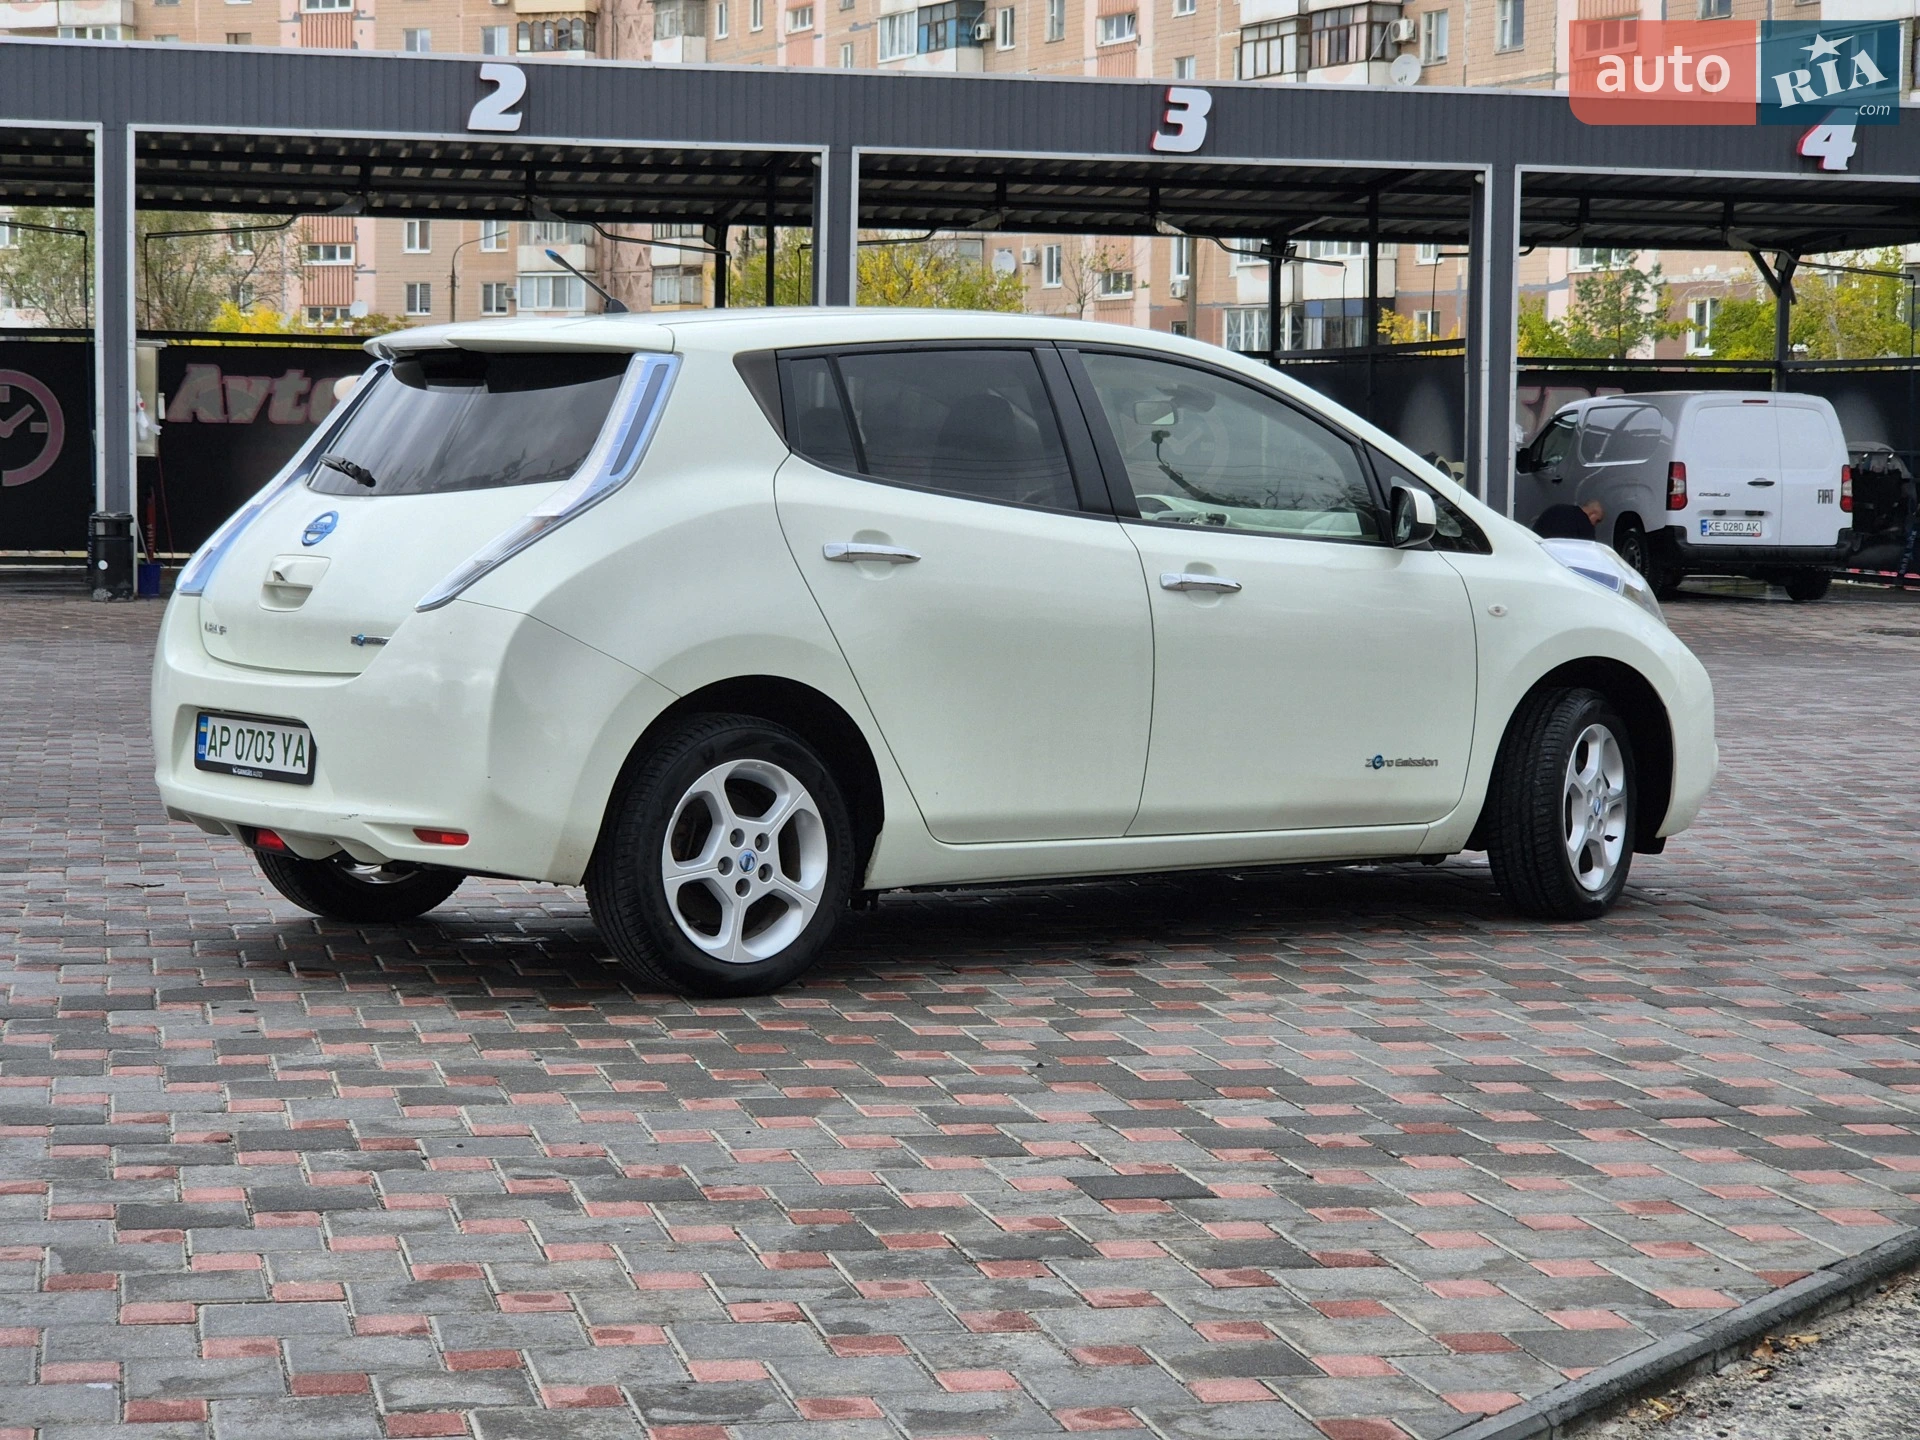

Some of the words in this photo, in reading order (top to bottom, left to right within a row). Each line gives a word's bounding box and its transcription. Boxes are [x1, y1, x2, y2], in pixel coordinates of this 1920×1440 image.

[467, 63, 527, 132] 2
[1150, 86, 1212, 153] 3
[1797, 107, 1859, 171] 4
[1817, 489, 1834, 505] FIAT
[1708, 521, 1721, 532] KE
[1723, 522, 1744, 532] 0280
[1746, 522, 1760, 532] AK
[207, 724, 232, 758] AP
[234, 727, 276, 764] 0703
[282, 732, 306, 769] YA
[1364, 754, 1394, 770] Zero
[1394, 757, 1439, 767] Emission
